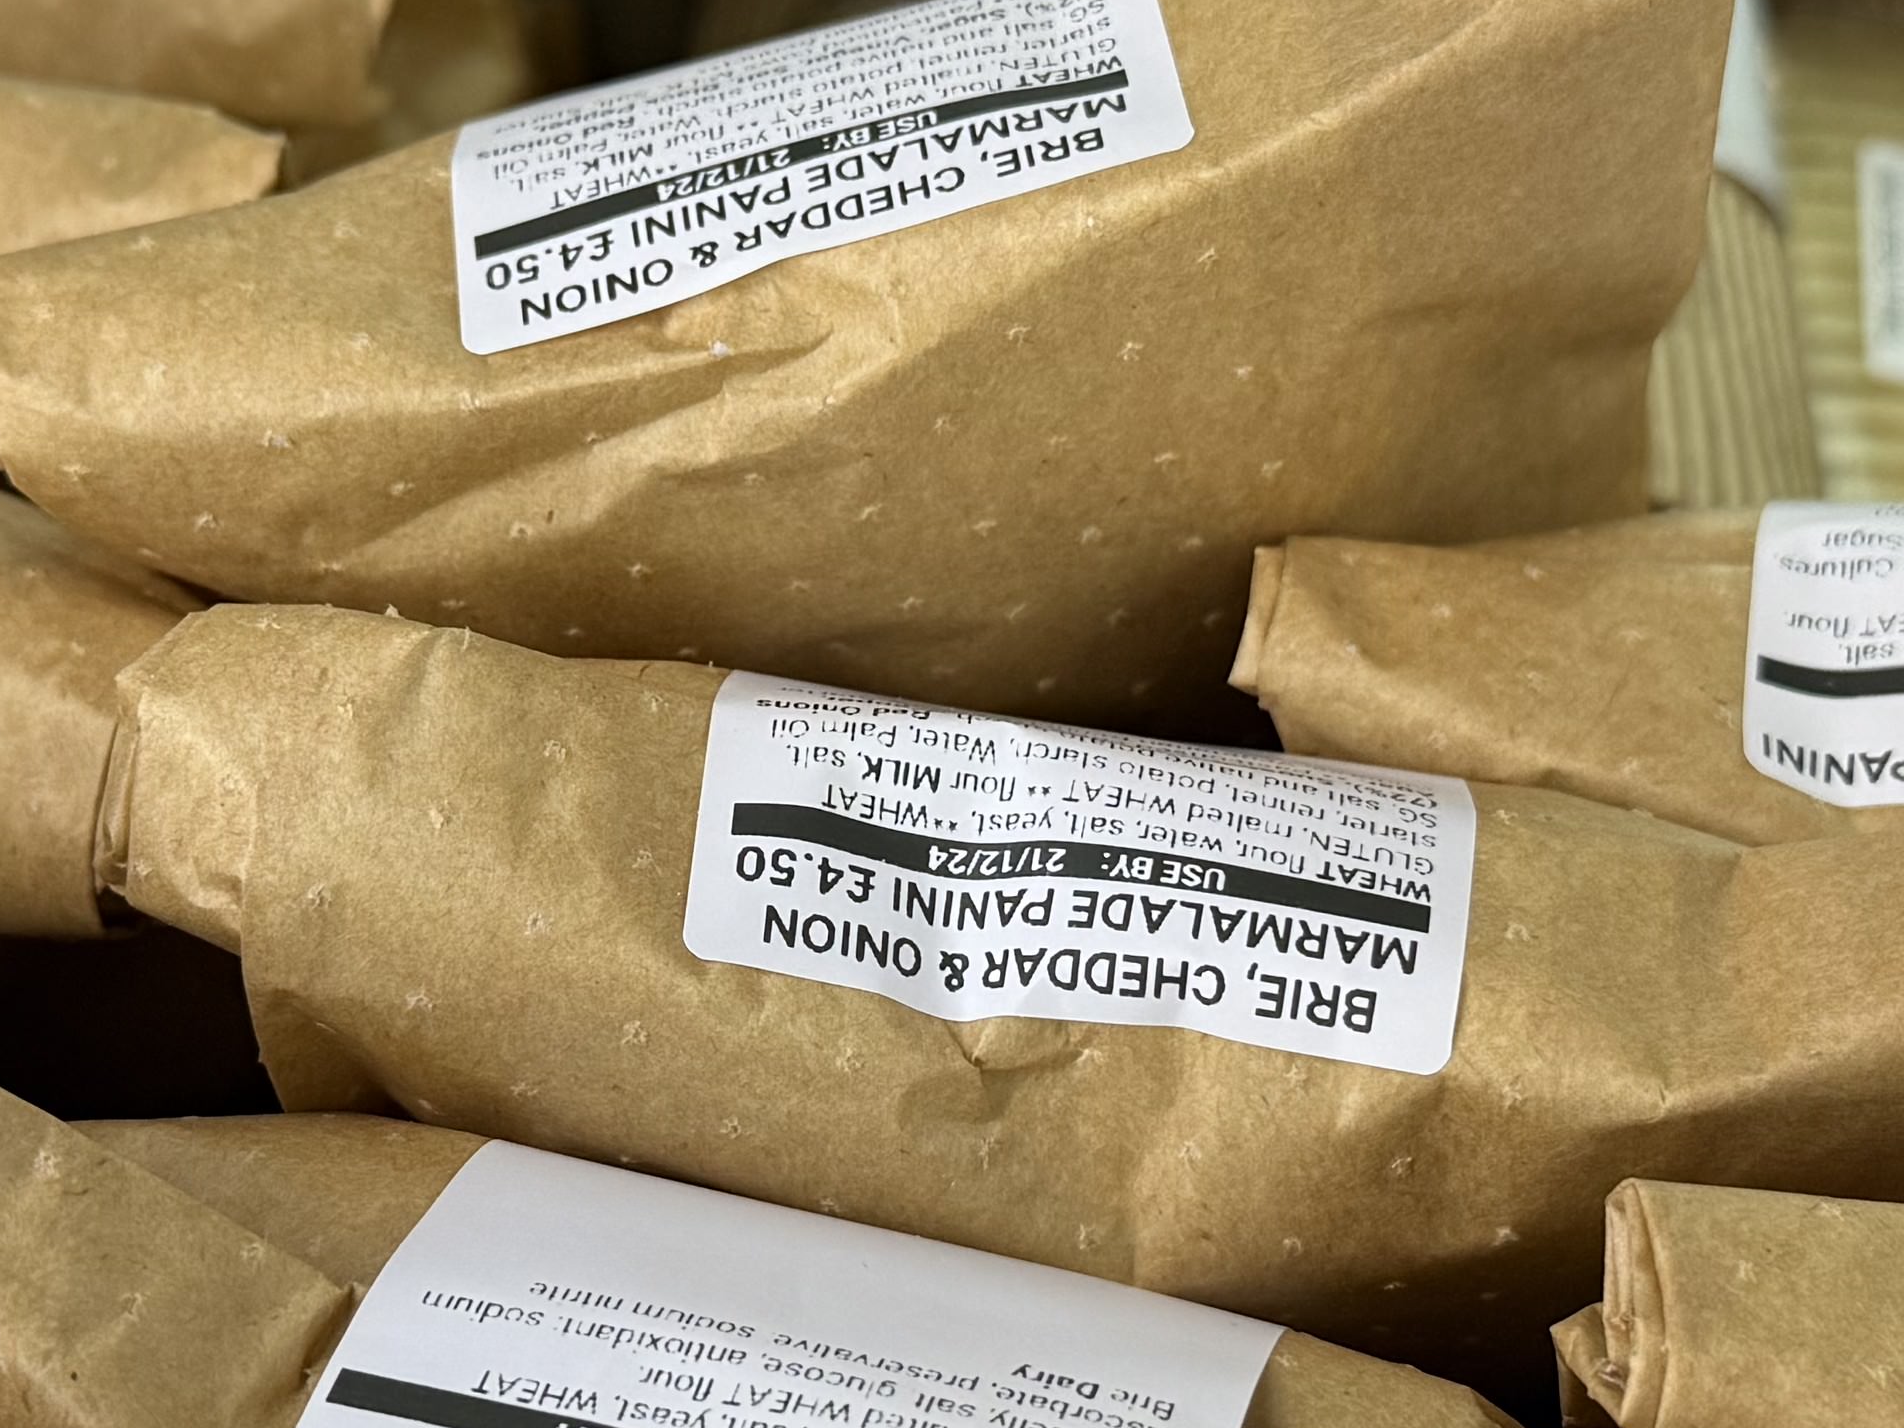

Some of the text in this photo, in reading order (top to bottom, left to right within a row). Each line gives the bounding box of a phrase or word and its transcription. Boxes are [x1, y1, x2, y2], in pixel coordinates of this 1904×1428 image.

[656, 112, 938, 200] USE BY: 21/12/24
[485, 94, 1126, 290] MARMALADE PANINI £4.50
[520, 127, 1104, 325] BRIE, CHEDDAR & ONION
[971, 808, 1052, 831] yeast,
[1064, 810, 1125, 837] salt,
[927, 846, 1226, 891] USE BY: 21/12/24
[1307, 861, 1431, 902] WHEAT
[736, 845, 1417, 974] MARMALADE PANINI £4.50
[763, 905, 1377, 1033] BRIE, CHEDDAR & ONION
[422, 1290, 545, 1326] sodium
[472, 1369, 599, 1414] WHEAT
[728, 1383, 850, 1423] WHEAT
[994, 1363, 1175, 1422] Brie Dairy
